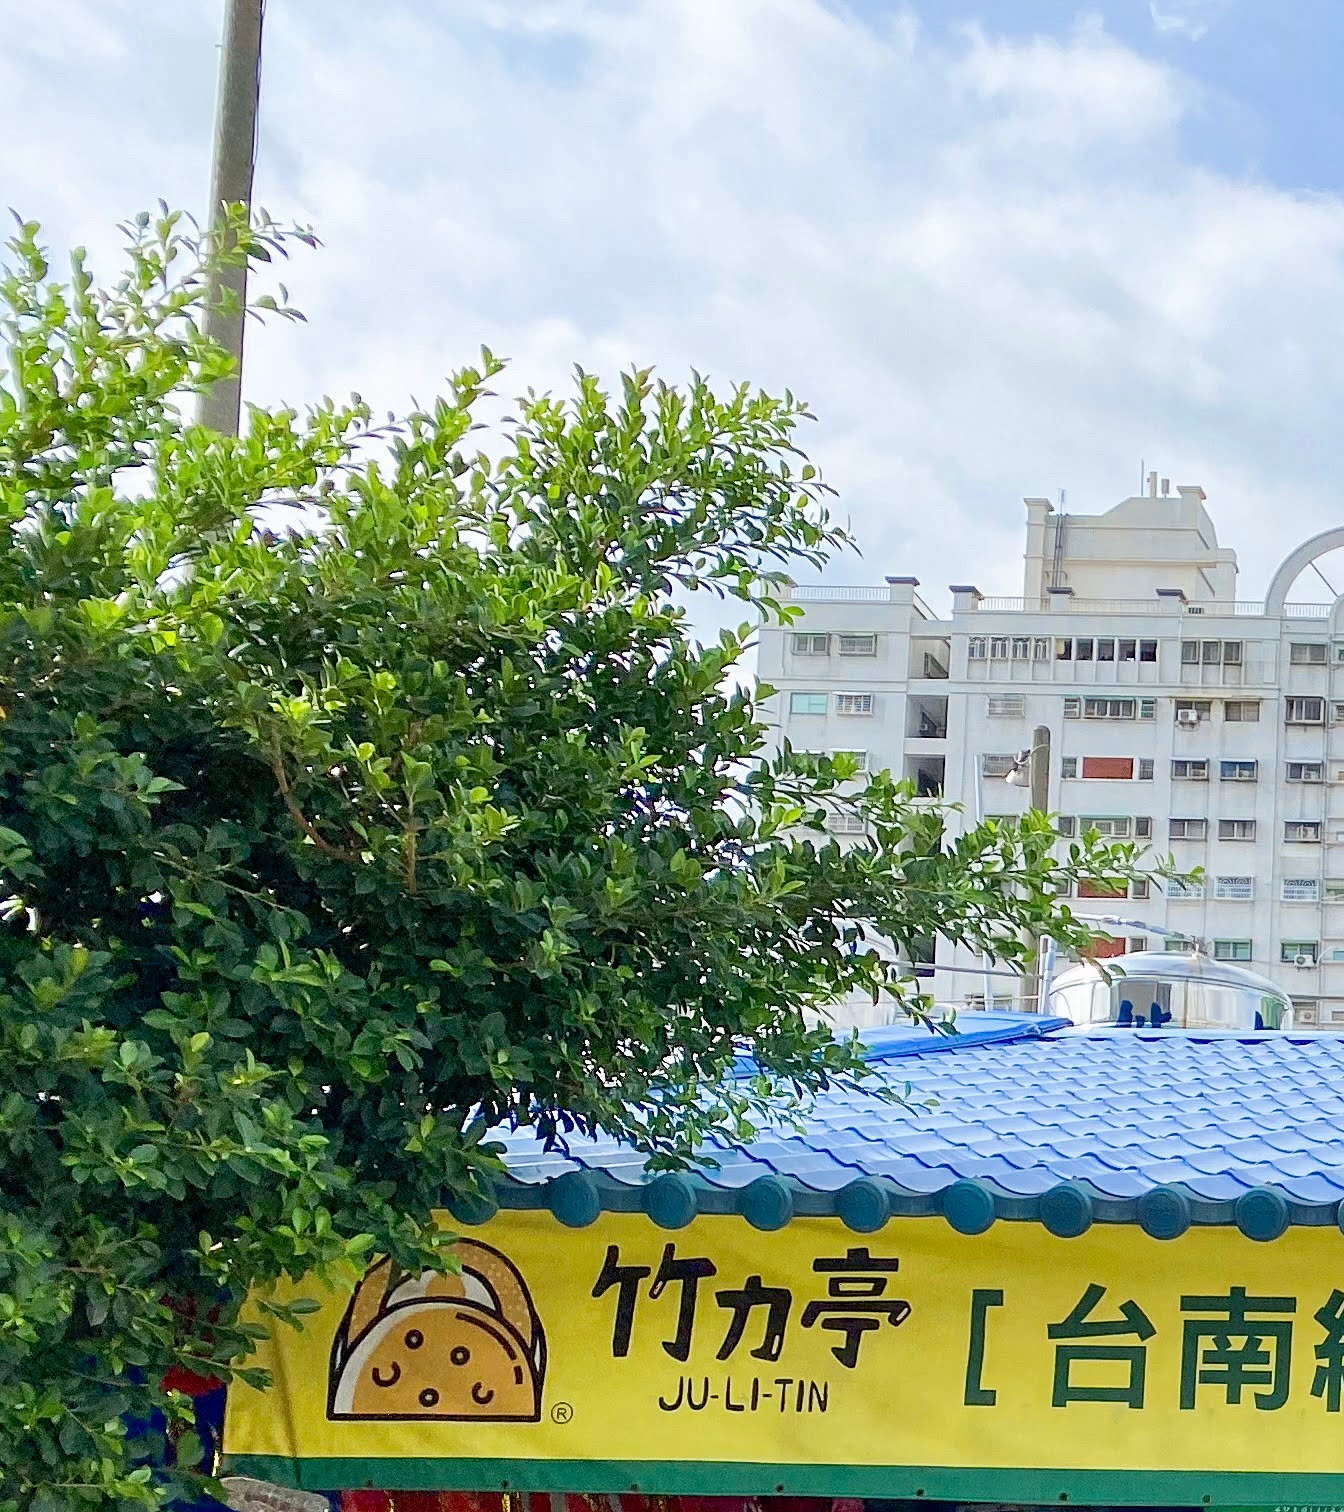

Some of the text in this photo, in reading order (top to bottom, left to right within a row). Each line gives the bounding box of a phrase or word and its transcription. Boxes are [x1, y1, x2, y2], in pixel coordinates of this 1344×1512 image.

[591, 1243, 911, 1368] 竹力亭
[658, 1376, 828, 1413] JU-LI-TIN
